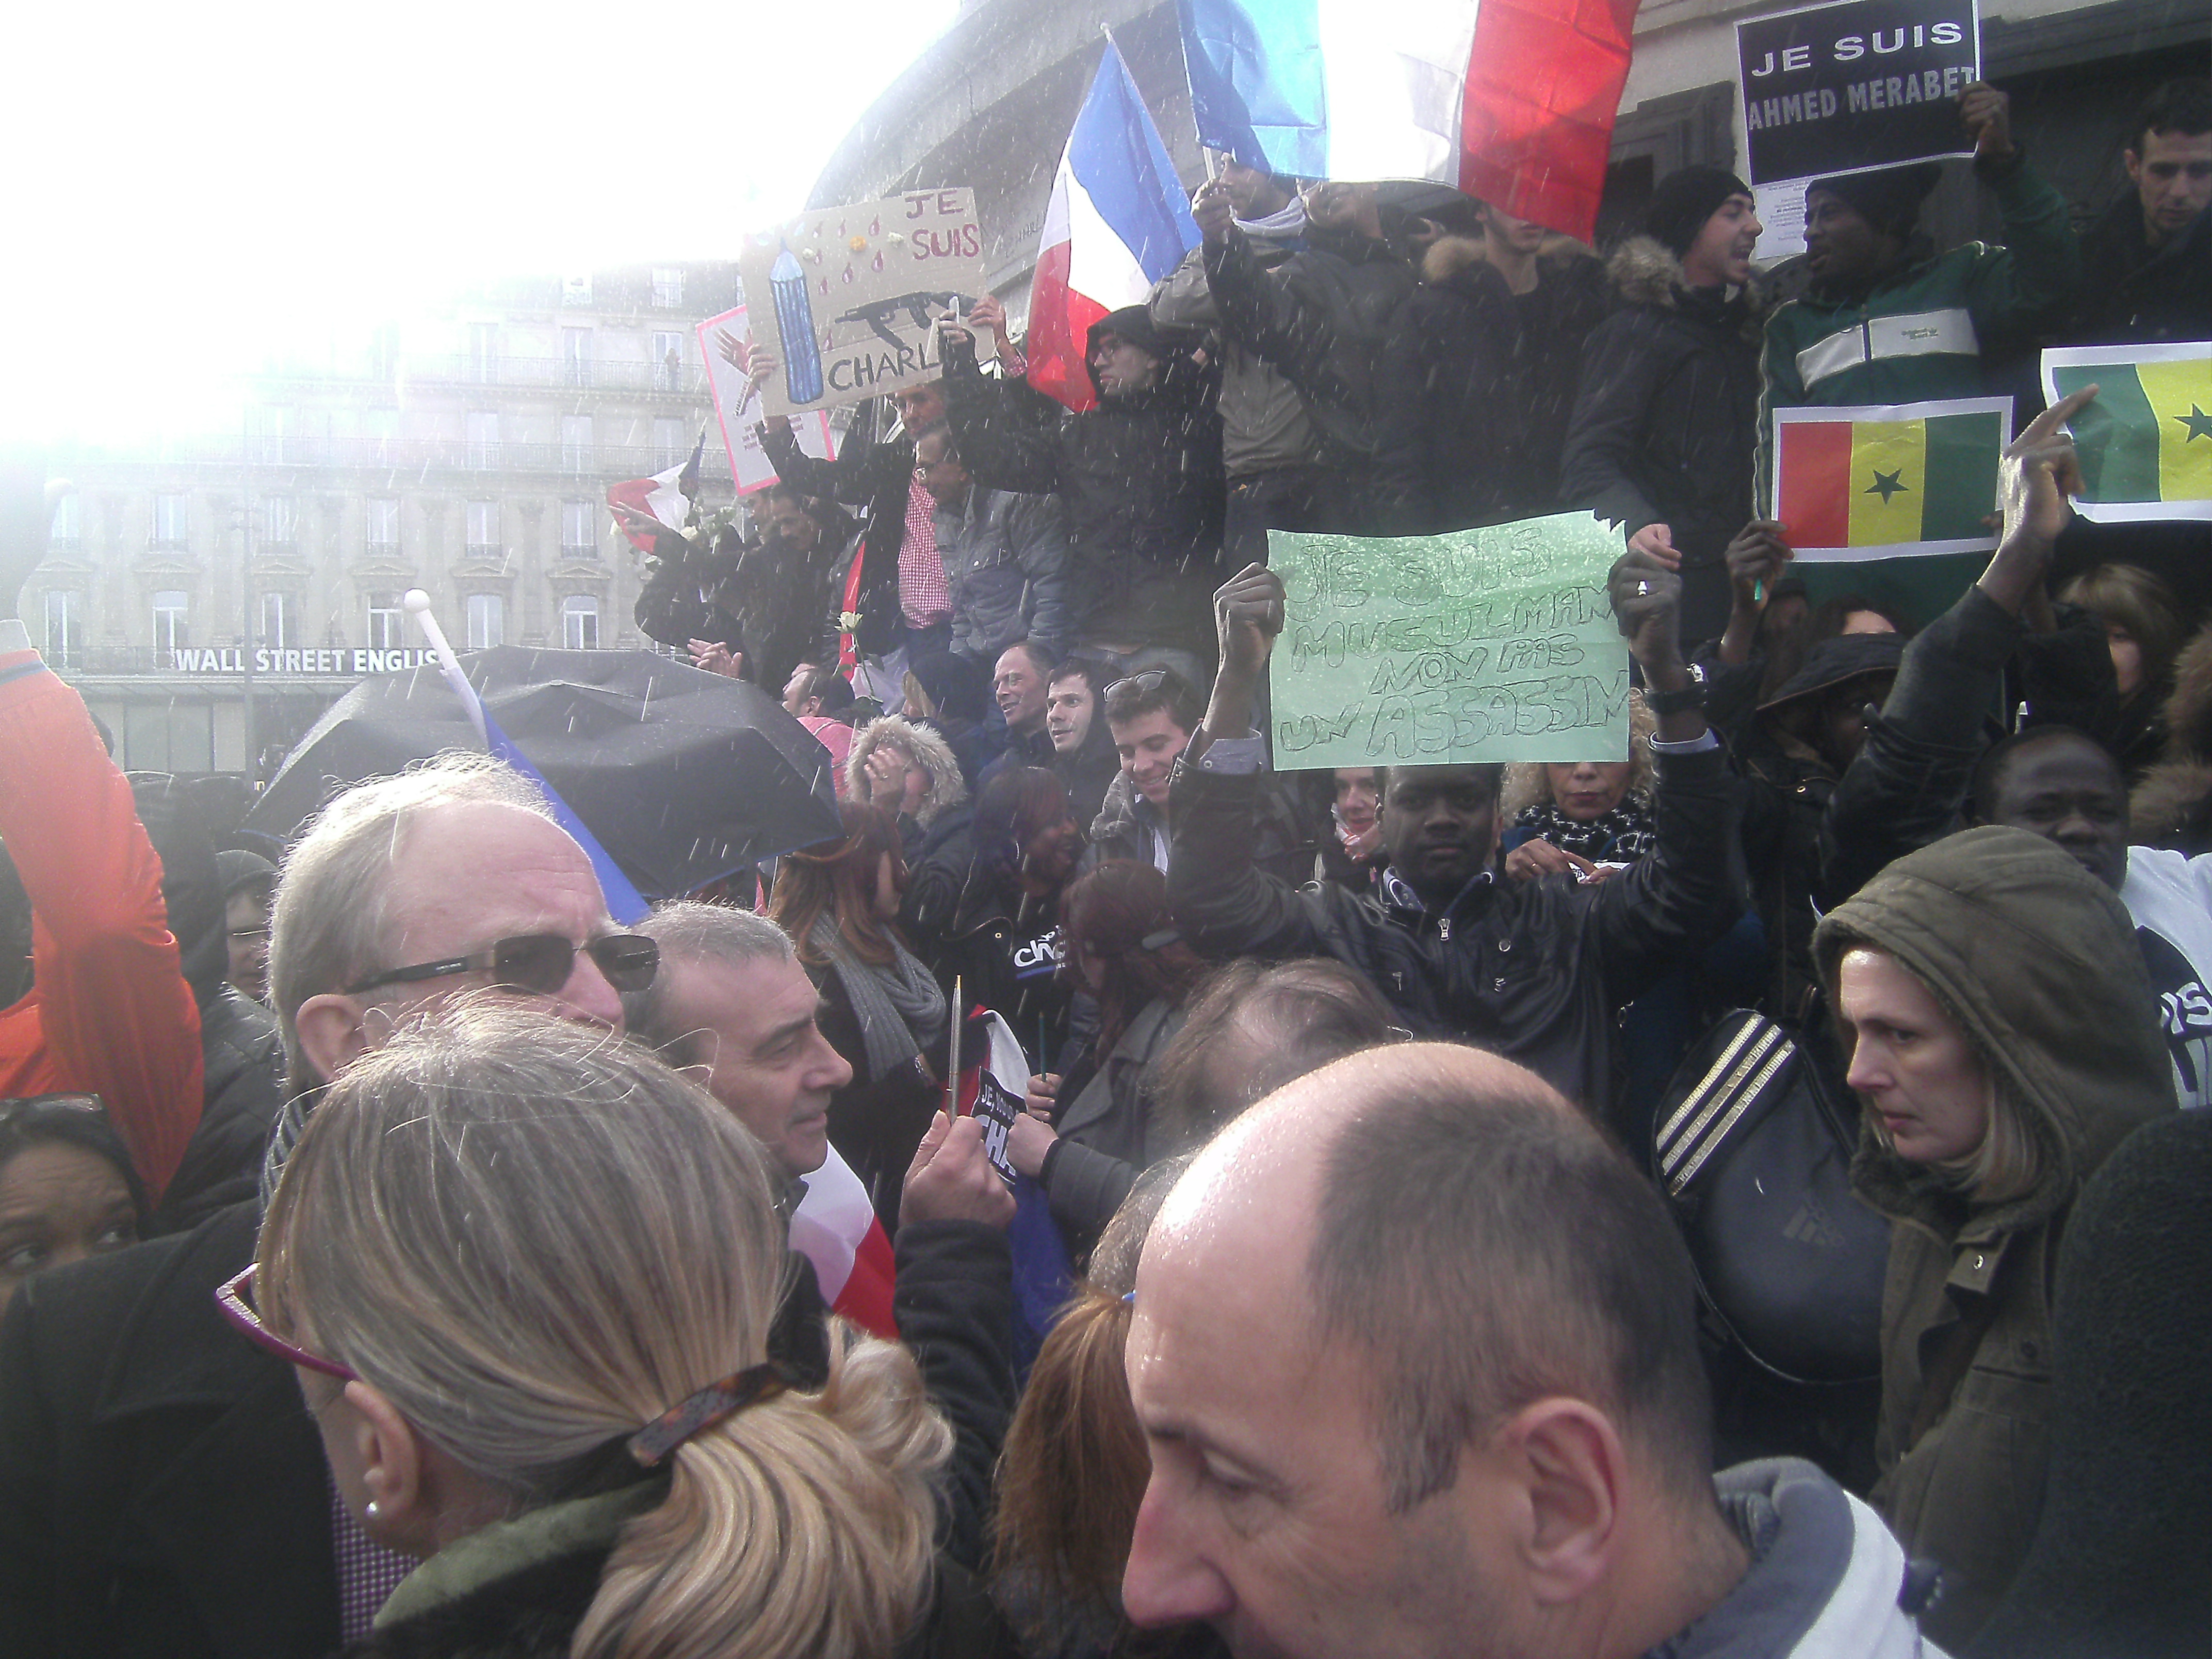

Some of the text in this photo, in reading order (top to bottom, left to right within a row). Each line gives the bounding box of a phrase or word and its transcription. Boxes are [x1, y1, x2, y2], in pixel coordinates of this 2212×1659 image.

[1751, 22, 1963, 77] JE SUIS
[1748, 66, 1975, 131] AHMED MERABET
[905, 190, 964, 219] JE
[912, 223, 979, 260] SUIS
[828, 343, 944, 391] CHARL
[1285, 527, 1552, 622] JE SUIS
[1291, 585, 1614, 672] MUSULMAN
[176, 648, 438, 672] WALL STREET ENGLIS
[1368, 633, 1585, 694] NON PAS
[1280, 670, 1629, 759] UN ASSASSIN
